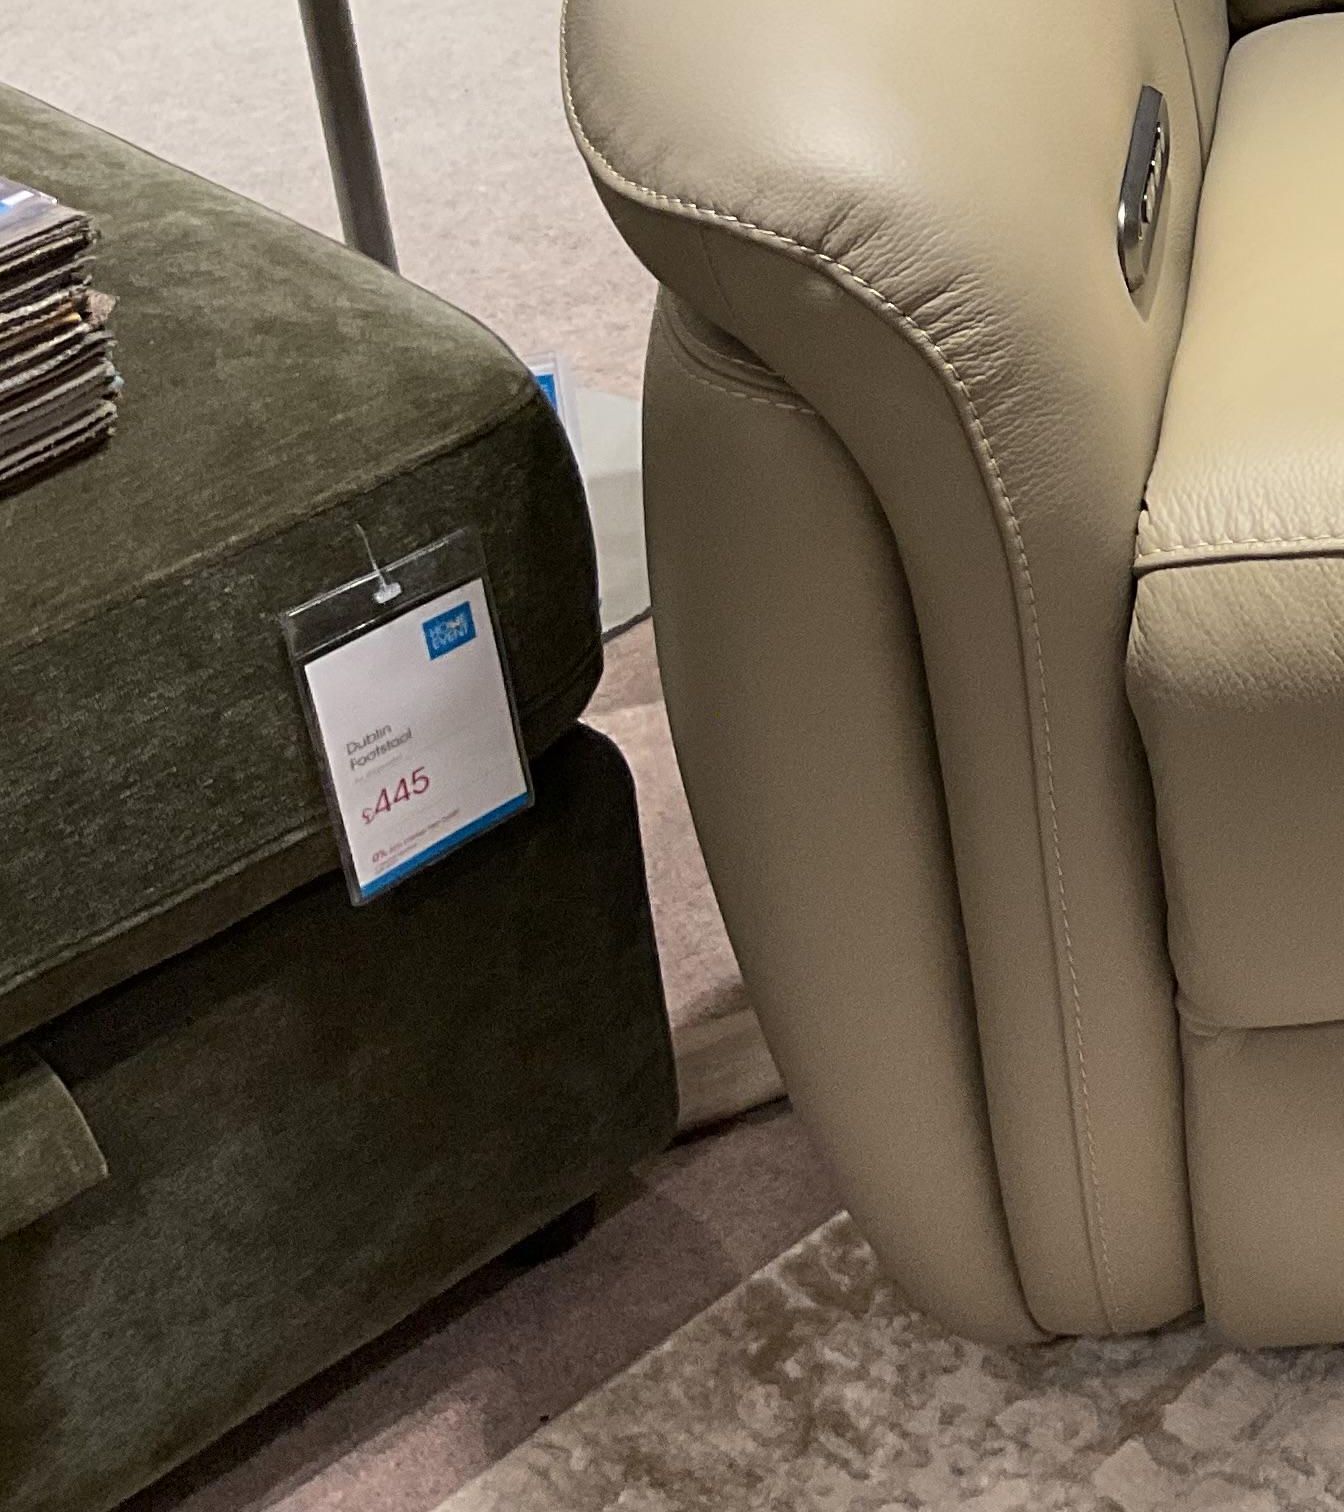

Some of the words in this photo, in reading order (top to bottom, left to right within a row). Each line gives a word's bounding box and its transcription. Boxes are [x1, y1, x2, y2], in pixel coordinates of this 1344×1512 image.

[346, 724, 393, 756] Dublin
[350, 728, 413, 771] Footstool
[362, 766, 430, 825] £445
